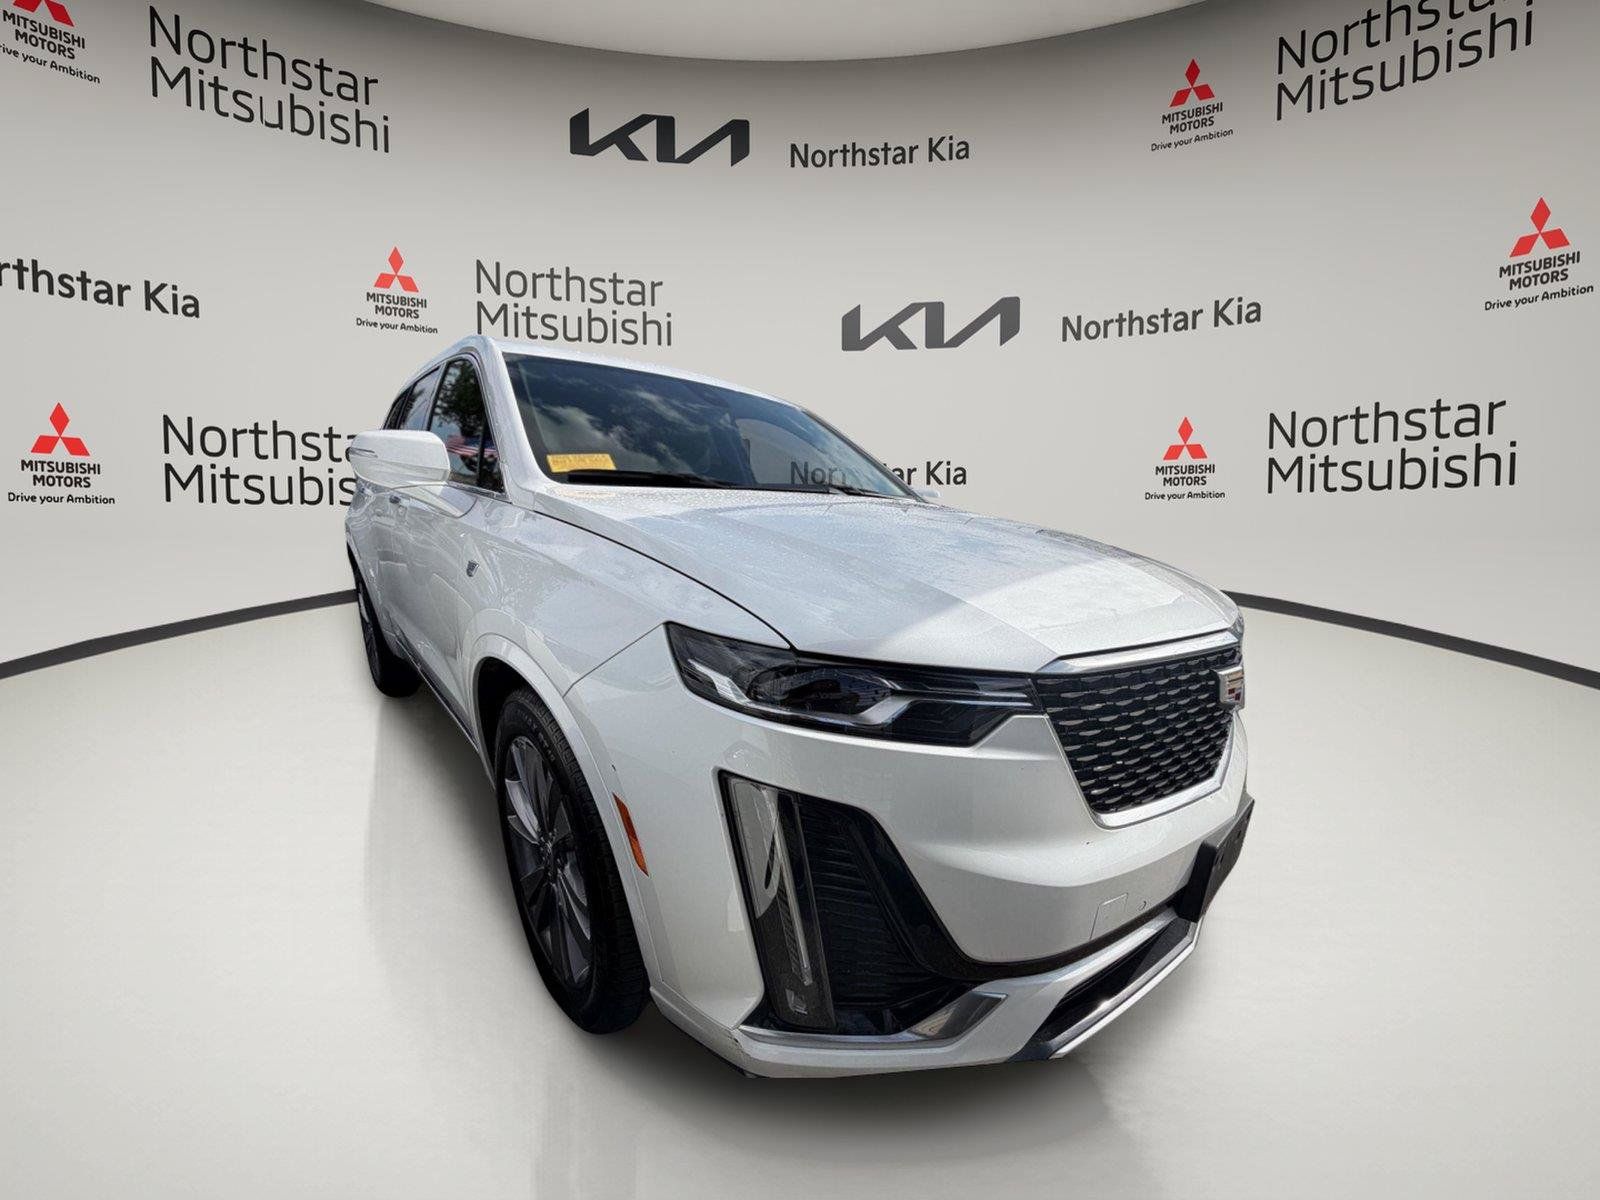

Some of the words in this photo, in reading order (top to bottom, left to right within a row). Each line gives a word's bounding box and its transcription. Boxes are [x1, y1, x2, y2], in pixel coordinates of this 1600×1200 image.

[3, 10, 85, 49] MITSUBISHI
[15, 29, 75, 59] MOTORS
[149, 5, 379, 105] Northstar
[0, 43, 20, 57] ive
[22, 53, 47, 66] your
[50, 61, 100, 83] Ambition
[1277, 0, 1533, 121] Mitsubishi
[151, 56, 389, 153] Mitsubishi
[1161, 102, 1223, 124] MITSUBISHI
[1170, 116, 1215, 134] MOTORS
[790, 142, 919, 168] Northstar
[928, 136, 970, 162] Kia
[1151, 142, 1172, 151] Drive
[1174, 138, 1193, 148] your
[1194, 129, 1234, 143] Ambition
[1499, 251, 1581, 278] MITSUBISHI
[0, 258, 132, 307] rthstar
[144, 280, 200, 318] Kia
[476, 259, 664, 306] Northstar
[1509, 268, 1569, 290] MOTORS
[366, 292, 427, 308] MITSUBISHI
[1484, 299, 1512, 311] Drive
[1515, 295, 1540, 308] your
[1541, 285, 1594, 301] Ambition
[356, 318, 378, 328] Drive
[380, 322, 399, 330] your
[400, 323, 438, 333] Ambition
[375, 305, 419, 319] MOTORS
[477, 301, 672, 346] Mitsubishi
[1062, 306, 1204, 342] Northstar
[1213, 296, 1262, 327] Kia
[1269, 398, 1507, 449] Northstar
[163, 414, 357, 463] Northst
[21, 460, 101, 475] MITSUBISHI
[926, 461, 967, 485] Kia
[1155, 464, 1216, 475] MITSUBISHI
[1267, 441, 1517, 494] Mitsubishi
[33, 475, 91, 488] MOTORS
[164, 463, 358, 506] Mitsubis
[1163, 476, 1207, 487] MOTORS
[8, 492, 37, 502] Drive
[40, 495, 64, 504] your
[67, 494, 115, 504] Ambition
[1144, 492, 1166, 500] Drive
[1187, 491, 1226, 499] Ambition
